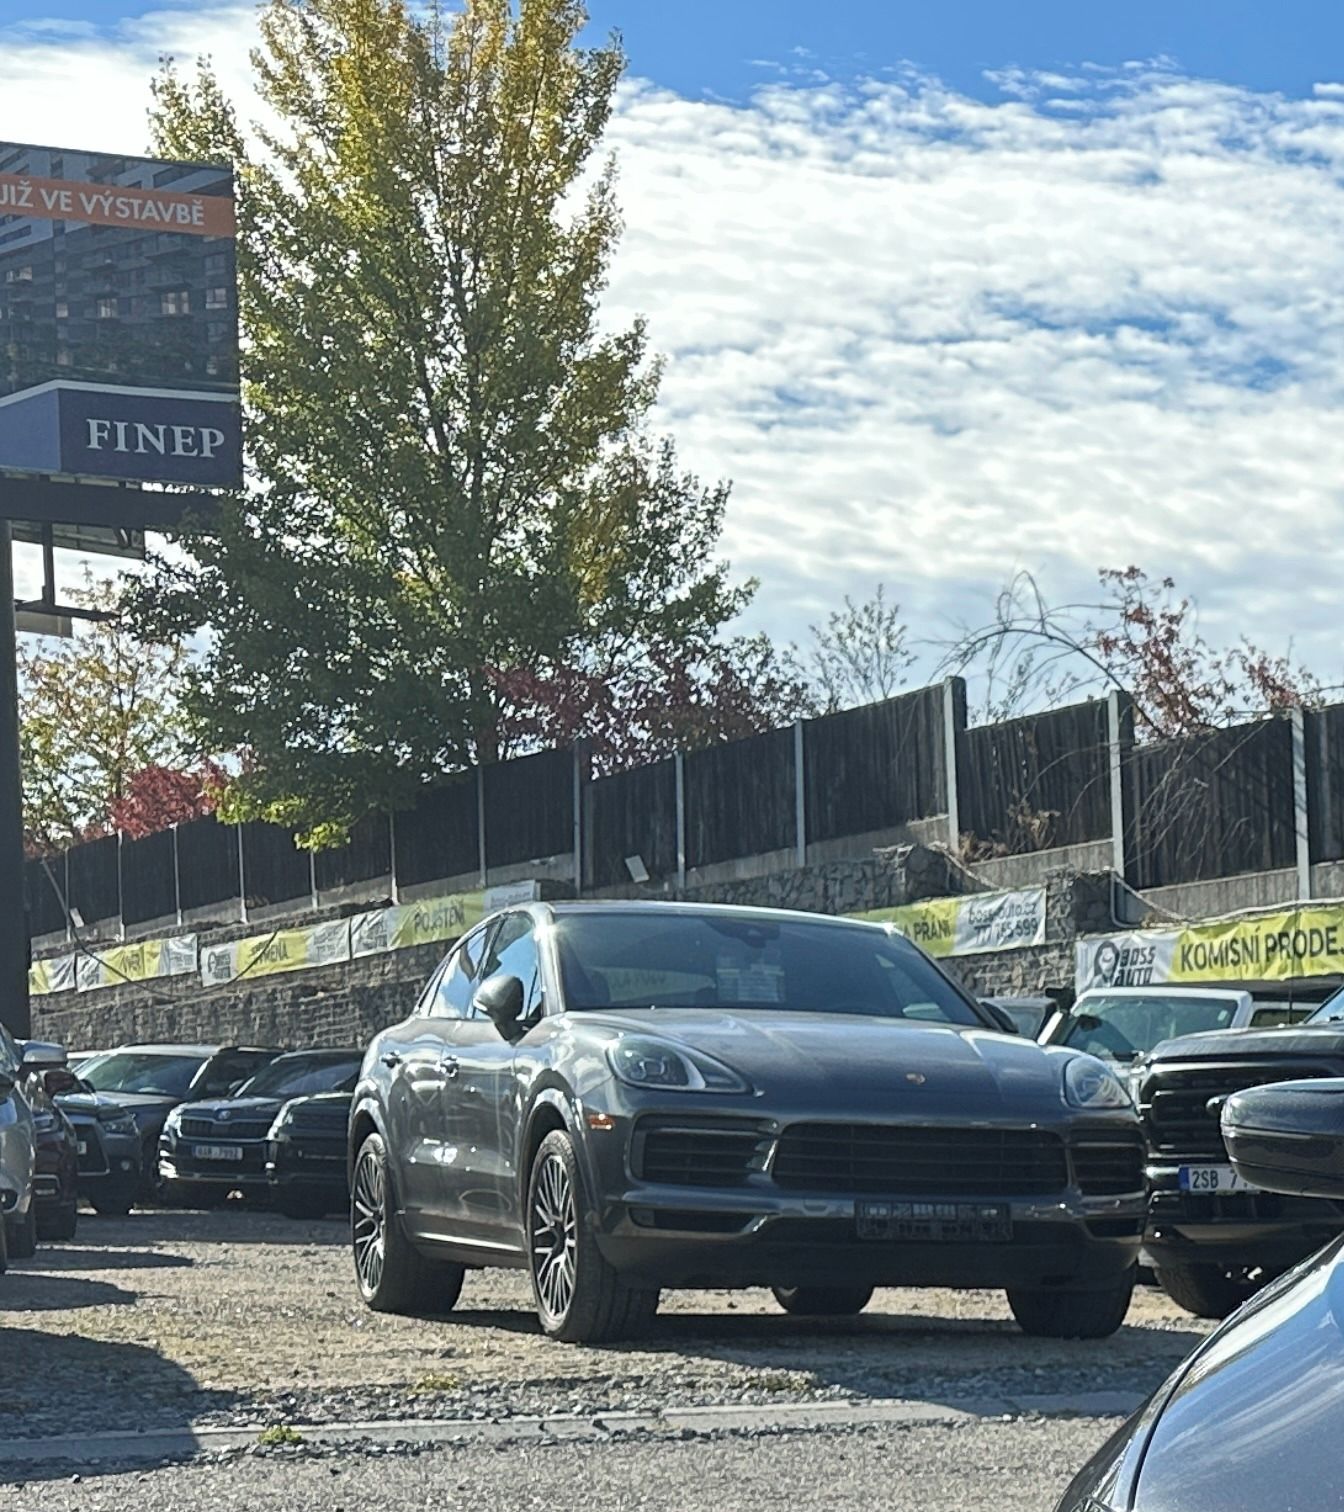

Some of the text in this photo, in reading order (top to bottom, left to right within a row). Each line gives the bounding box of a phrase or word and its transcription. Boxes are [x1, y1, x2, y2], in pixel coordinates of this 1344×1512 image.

[40, 187, 74, 213] VE
[78, 189, 206, 226] VÝSTAVBĚ
[86, 418, 226, 458] FINEP
[1119, 946, 1157, 967] BOSS
[1180, 929, 1260, 972] KOMISNÍ
[1191, 1169, 1220, 1189] 2SB
